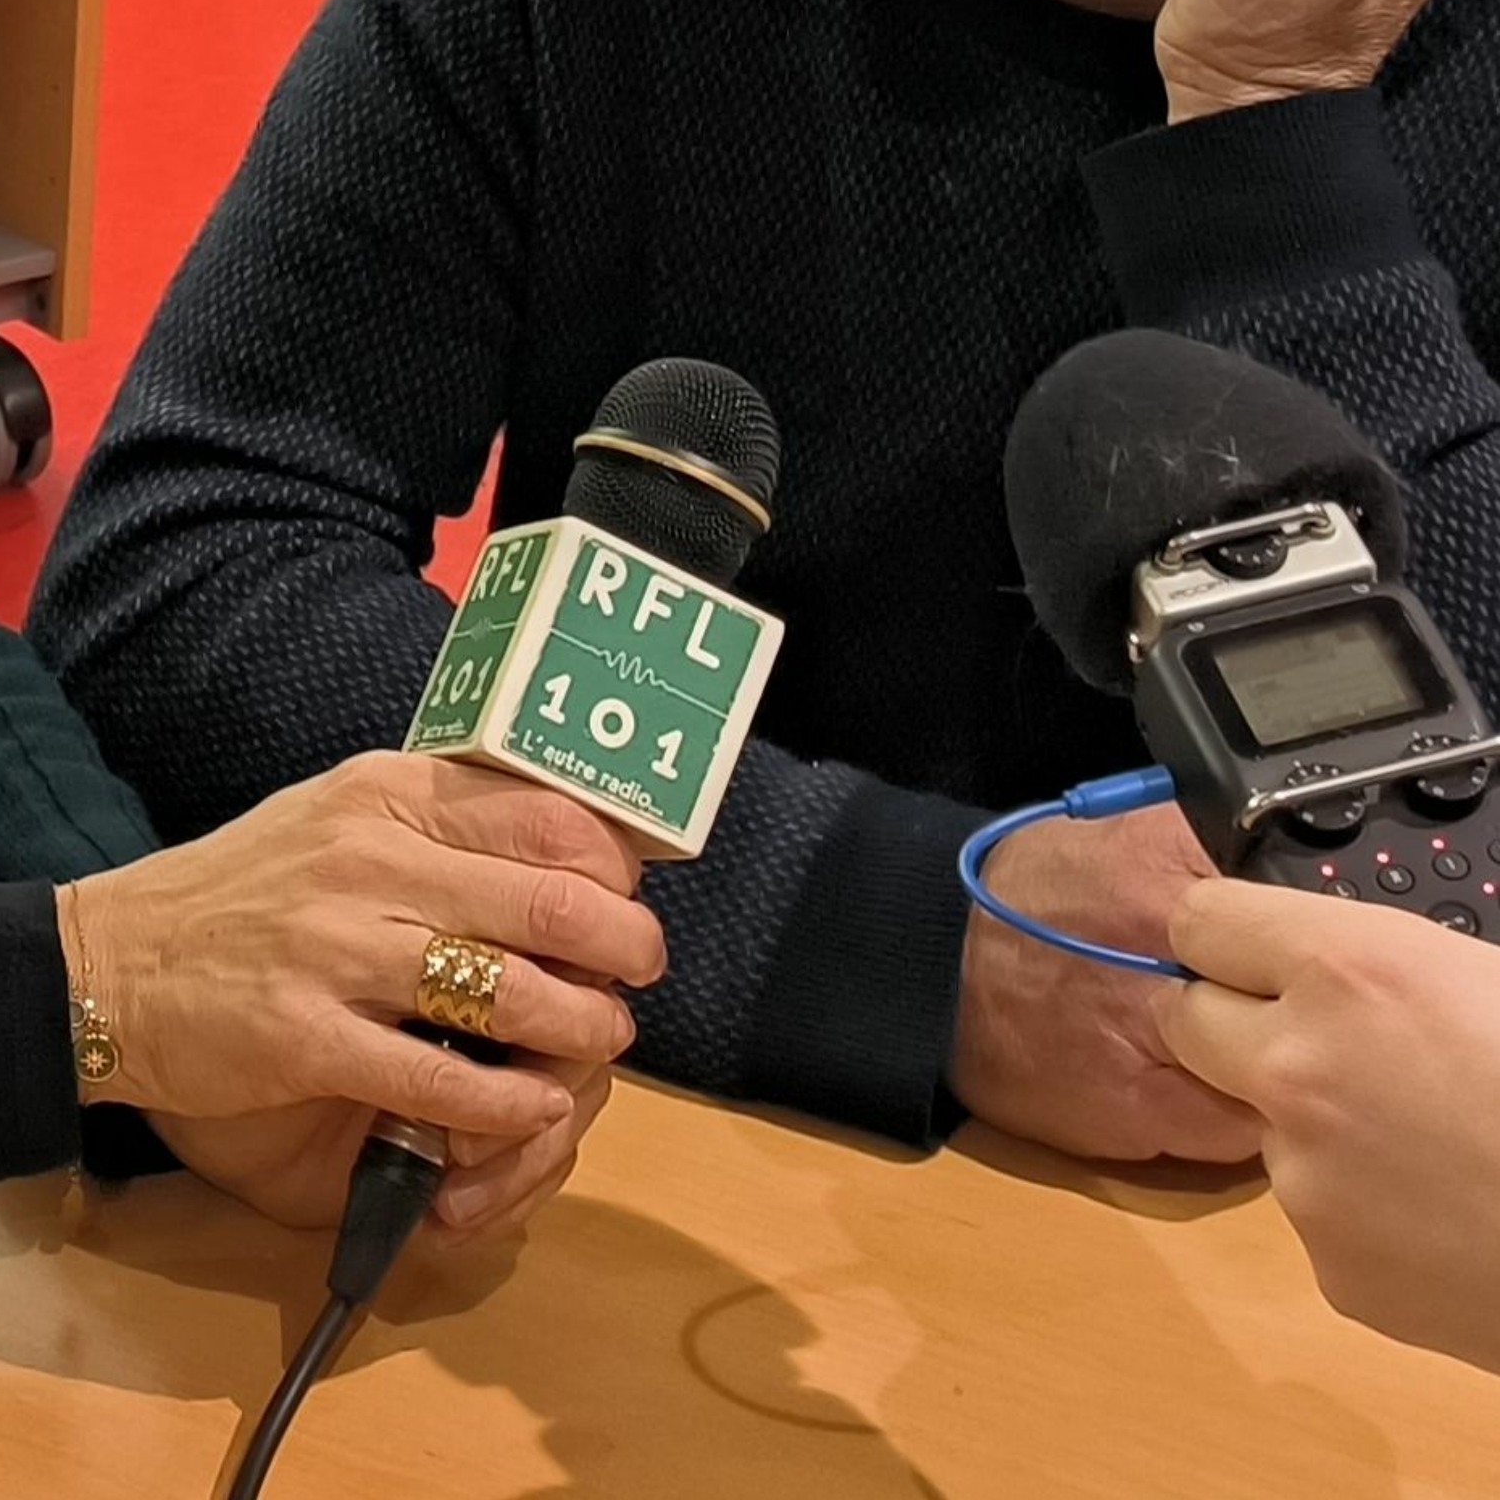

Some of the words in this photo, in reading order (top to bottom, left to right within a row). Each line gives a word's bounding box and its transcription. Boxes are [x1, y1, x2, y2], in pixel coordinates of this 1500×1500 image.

[470, 538, 535, 602] RFL
[579, 544, 721, 670] RFL
[430, 656, 494, 708] 101
[538, 673, 684, 781] 101
